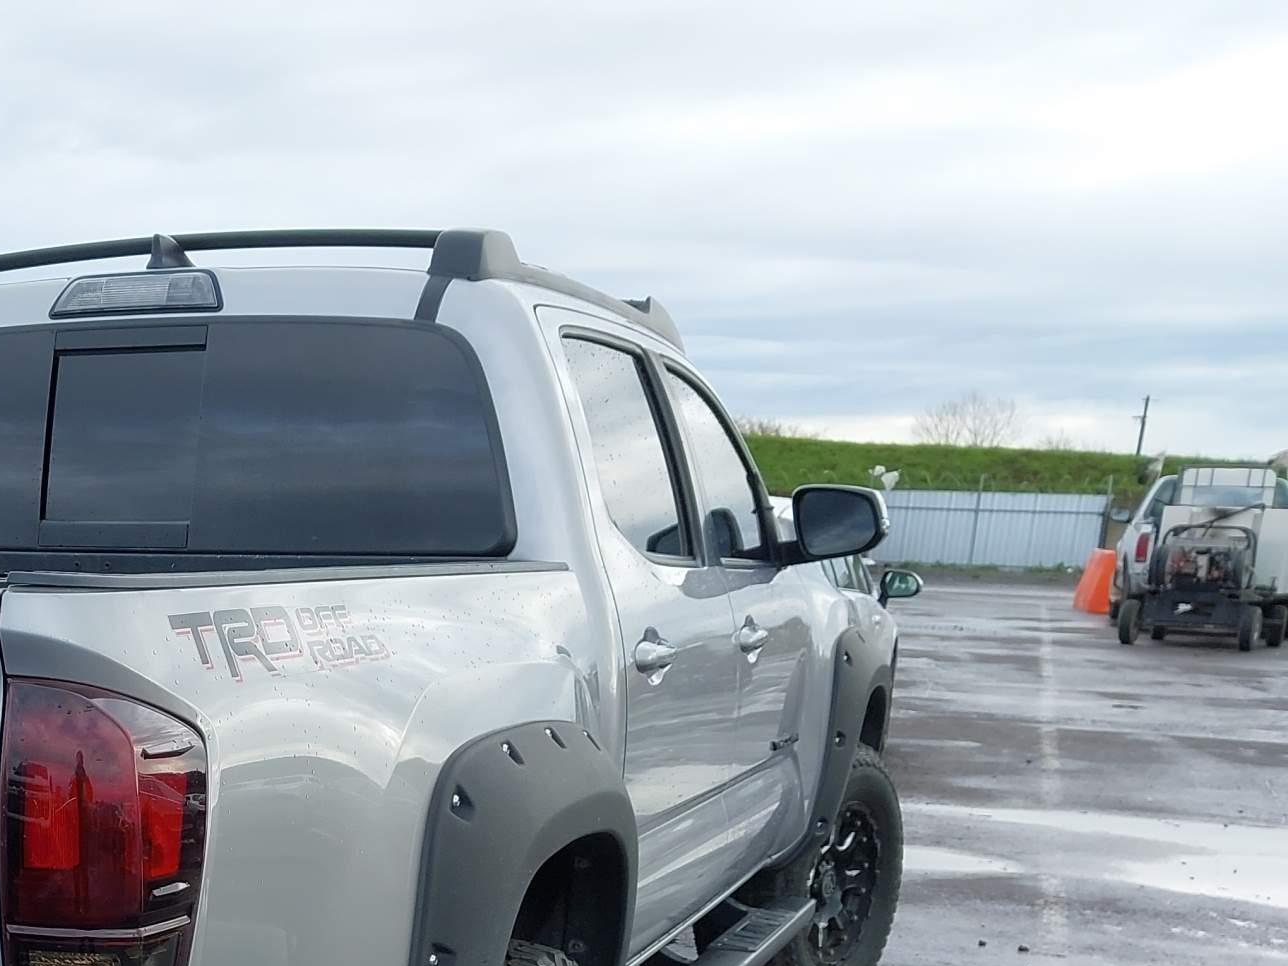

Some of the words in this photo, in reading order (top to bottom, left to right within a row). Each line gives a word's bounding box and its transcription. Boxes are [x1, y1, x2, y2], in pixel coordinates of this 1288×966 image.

[167, 605, 303, 682] TRD
[294, 603, 351, 635] OFF
[306, 633, 392, 672] ROAD
